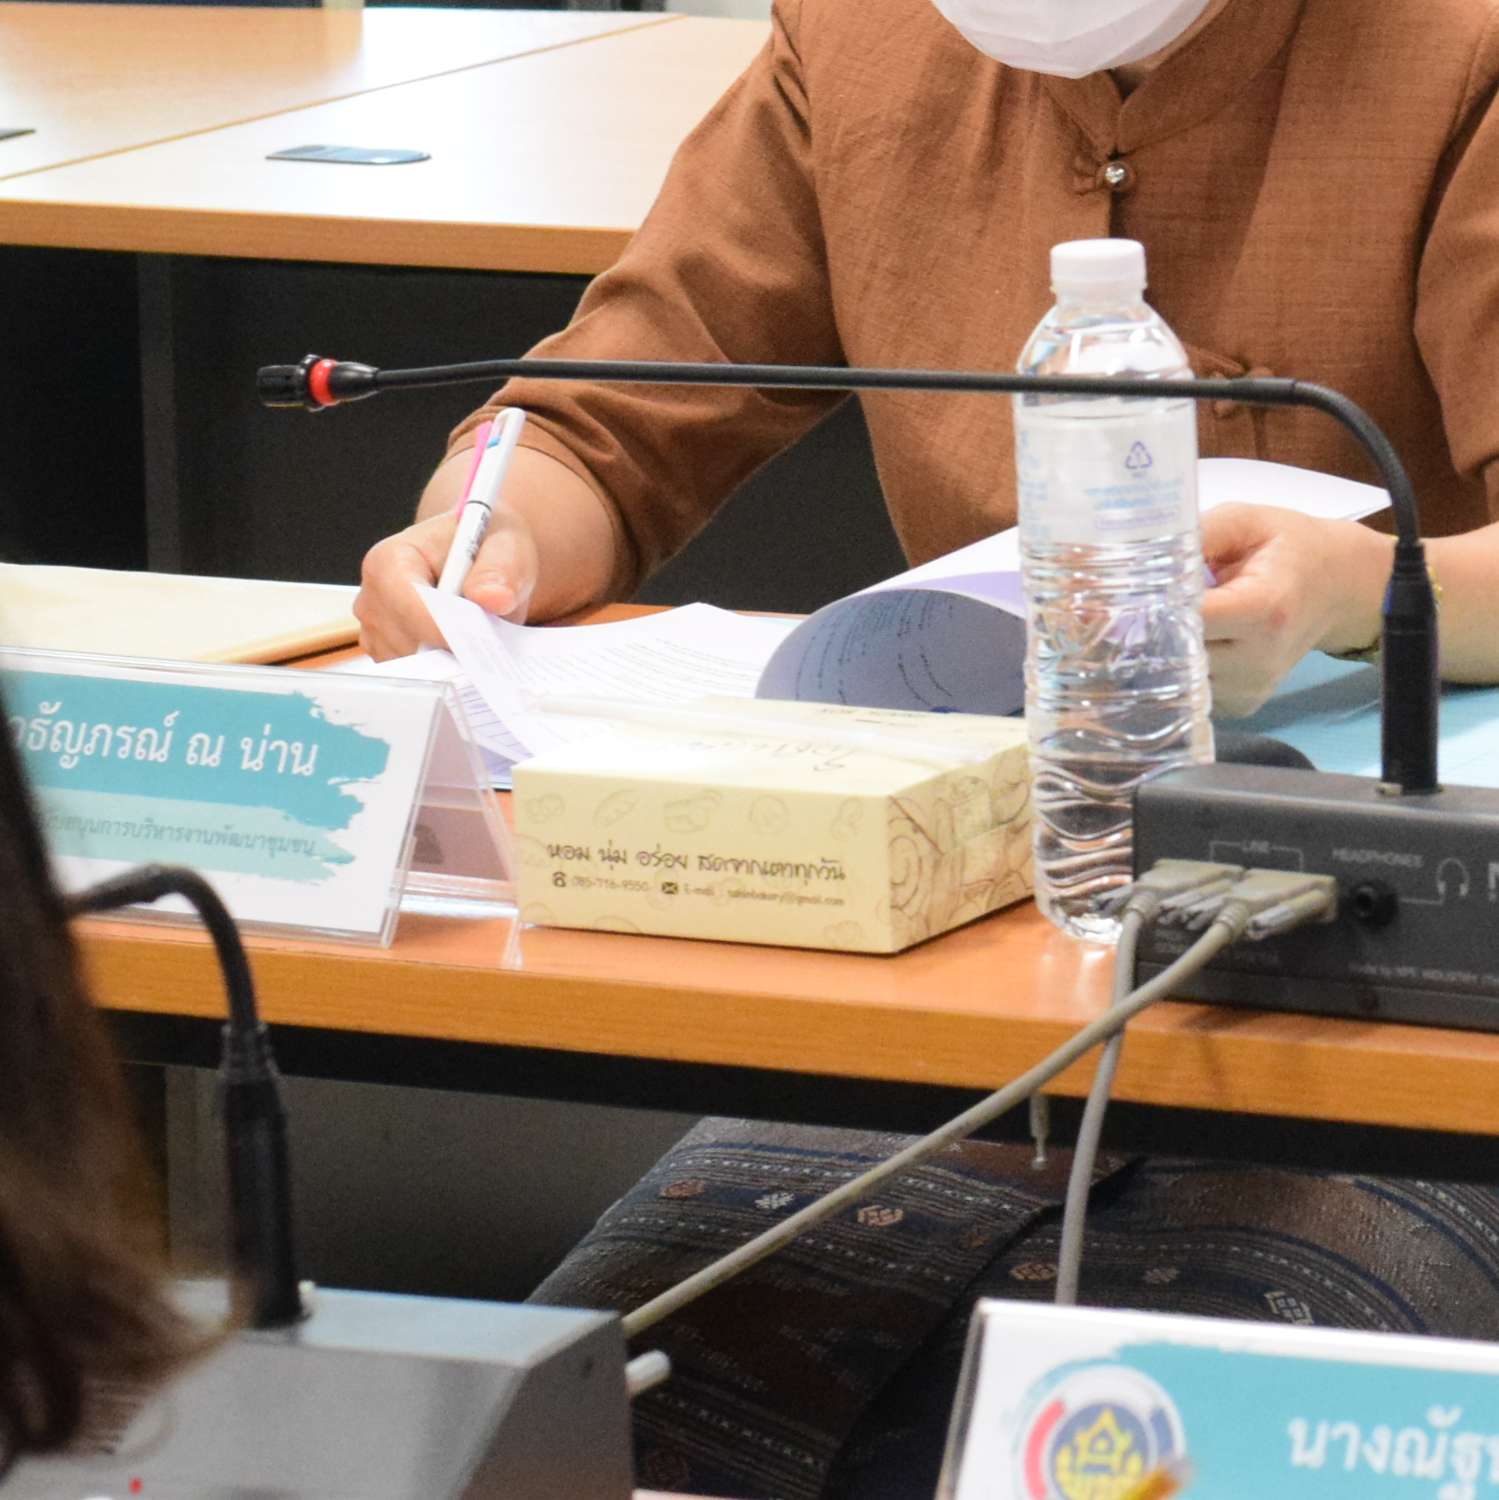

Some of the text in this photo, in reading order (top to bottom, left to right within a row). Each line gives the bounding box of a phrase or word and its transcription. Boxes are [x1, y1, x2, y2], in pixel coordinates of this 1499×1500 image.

[186, 732, 225, 767] ณ
[240, 723, 318, 776] น่าน
[546, 843, 590, 862] หอม
[598, 839, 628, 871] นุ่ม
[635, 844, 688, 870] อร่อย
[1331, 848, 1424, 869] HEADPHONES
